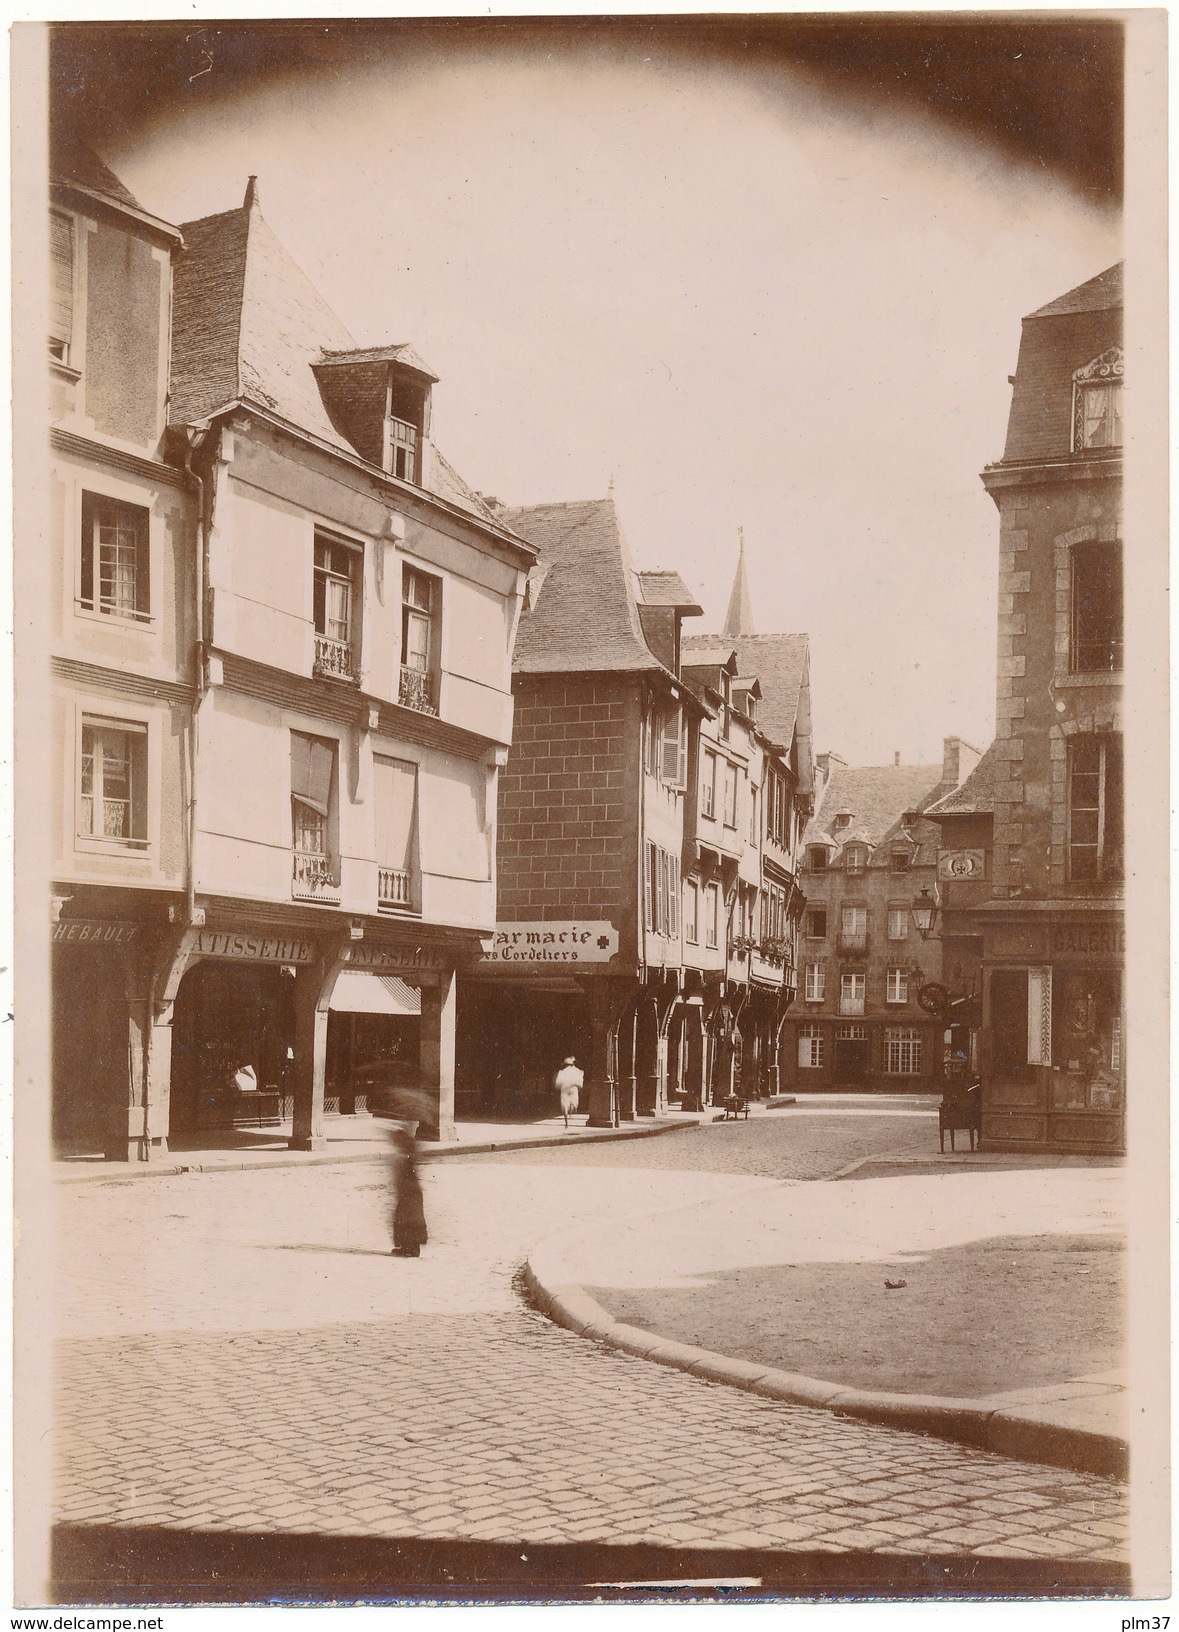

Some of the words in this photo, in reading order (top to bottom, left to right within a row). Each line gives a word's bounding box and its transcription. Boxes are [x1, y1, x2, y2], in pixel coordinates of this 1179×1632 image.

[52, 923, 138, 942] HEBAULT
[494, 926, 592, 945] armacie
[191, 931, 312, 961] ÂTISSERIE
[484, 951, 498, 960] es
[501, 945, 578, 961] Cordeliers
